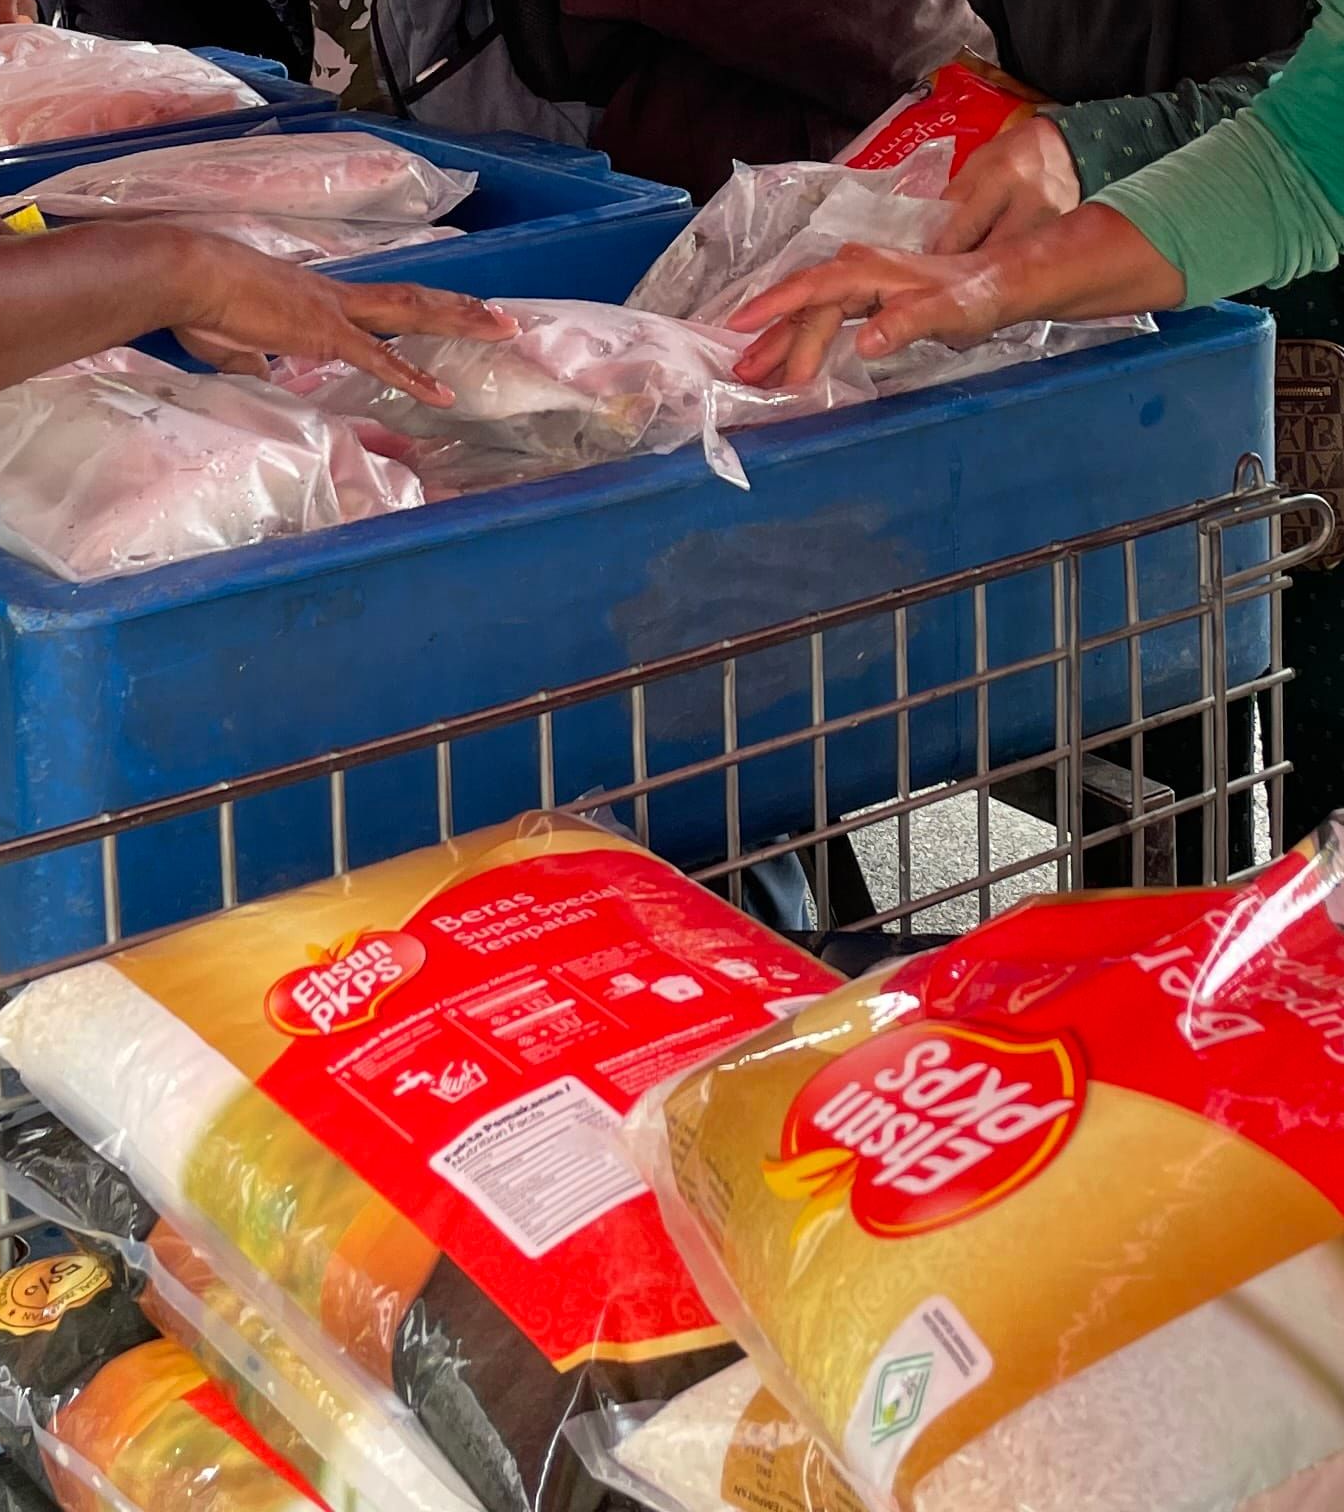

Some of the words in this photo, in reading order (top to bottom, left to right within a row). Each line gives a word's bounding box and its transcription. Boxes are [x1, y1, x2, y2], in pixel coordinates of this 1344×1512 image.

[896, 110, 957, 161] Super
[431, 891, 537, 934] Beras
[453, 911, 530, 947] Super
[531, 884, 623, 921] Special
[467, 906, 598, 957] Tempatan
[291, 937, 394, 1014] Ehsan
[309, 955, 404, 1036] PKPS
[1130, 944, 1266, 1052] Ber
[874, 1039, 1076, 1144] PKPS
[812, 1080, 995, 1196] Ehsan
[24, 1260, 82, 1296] 5%
